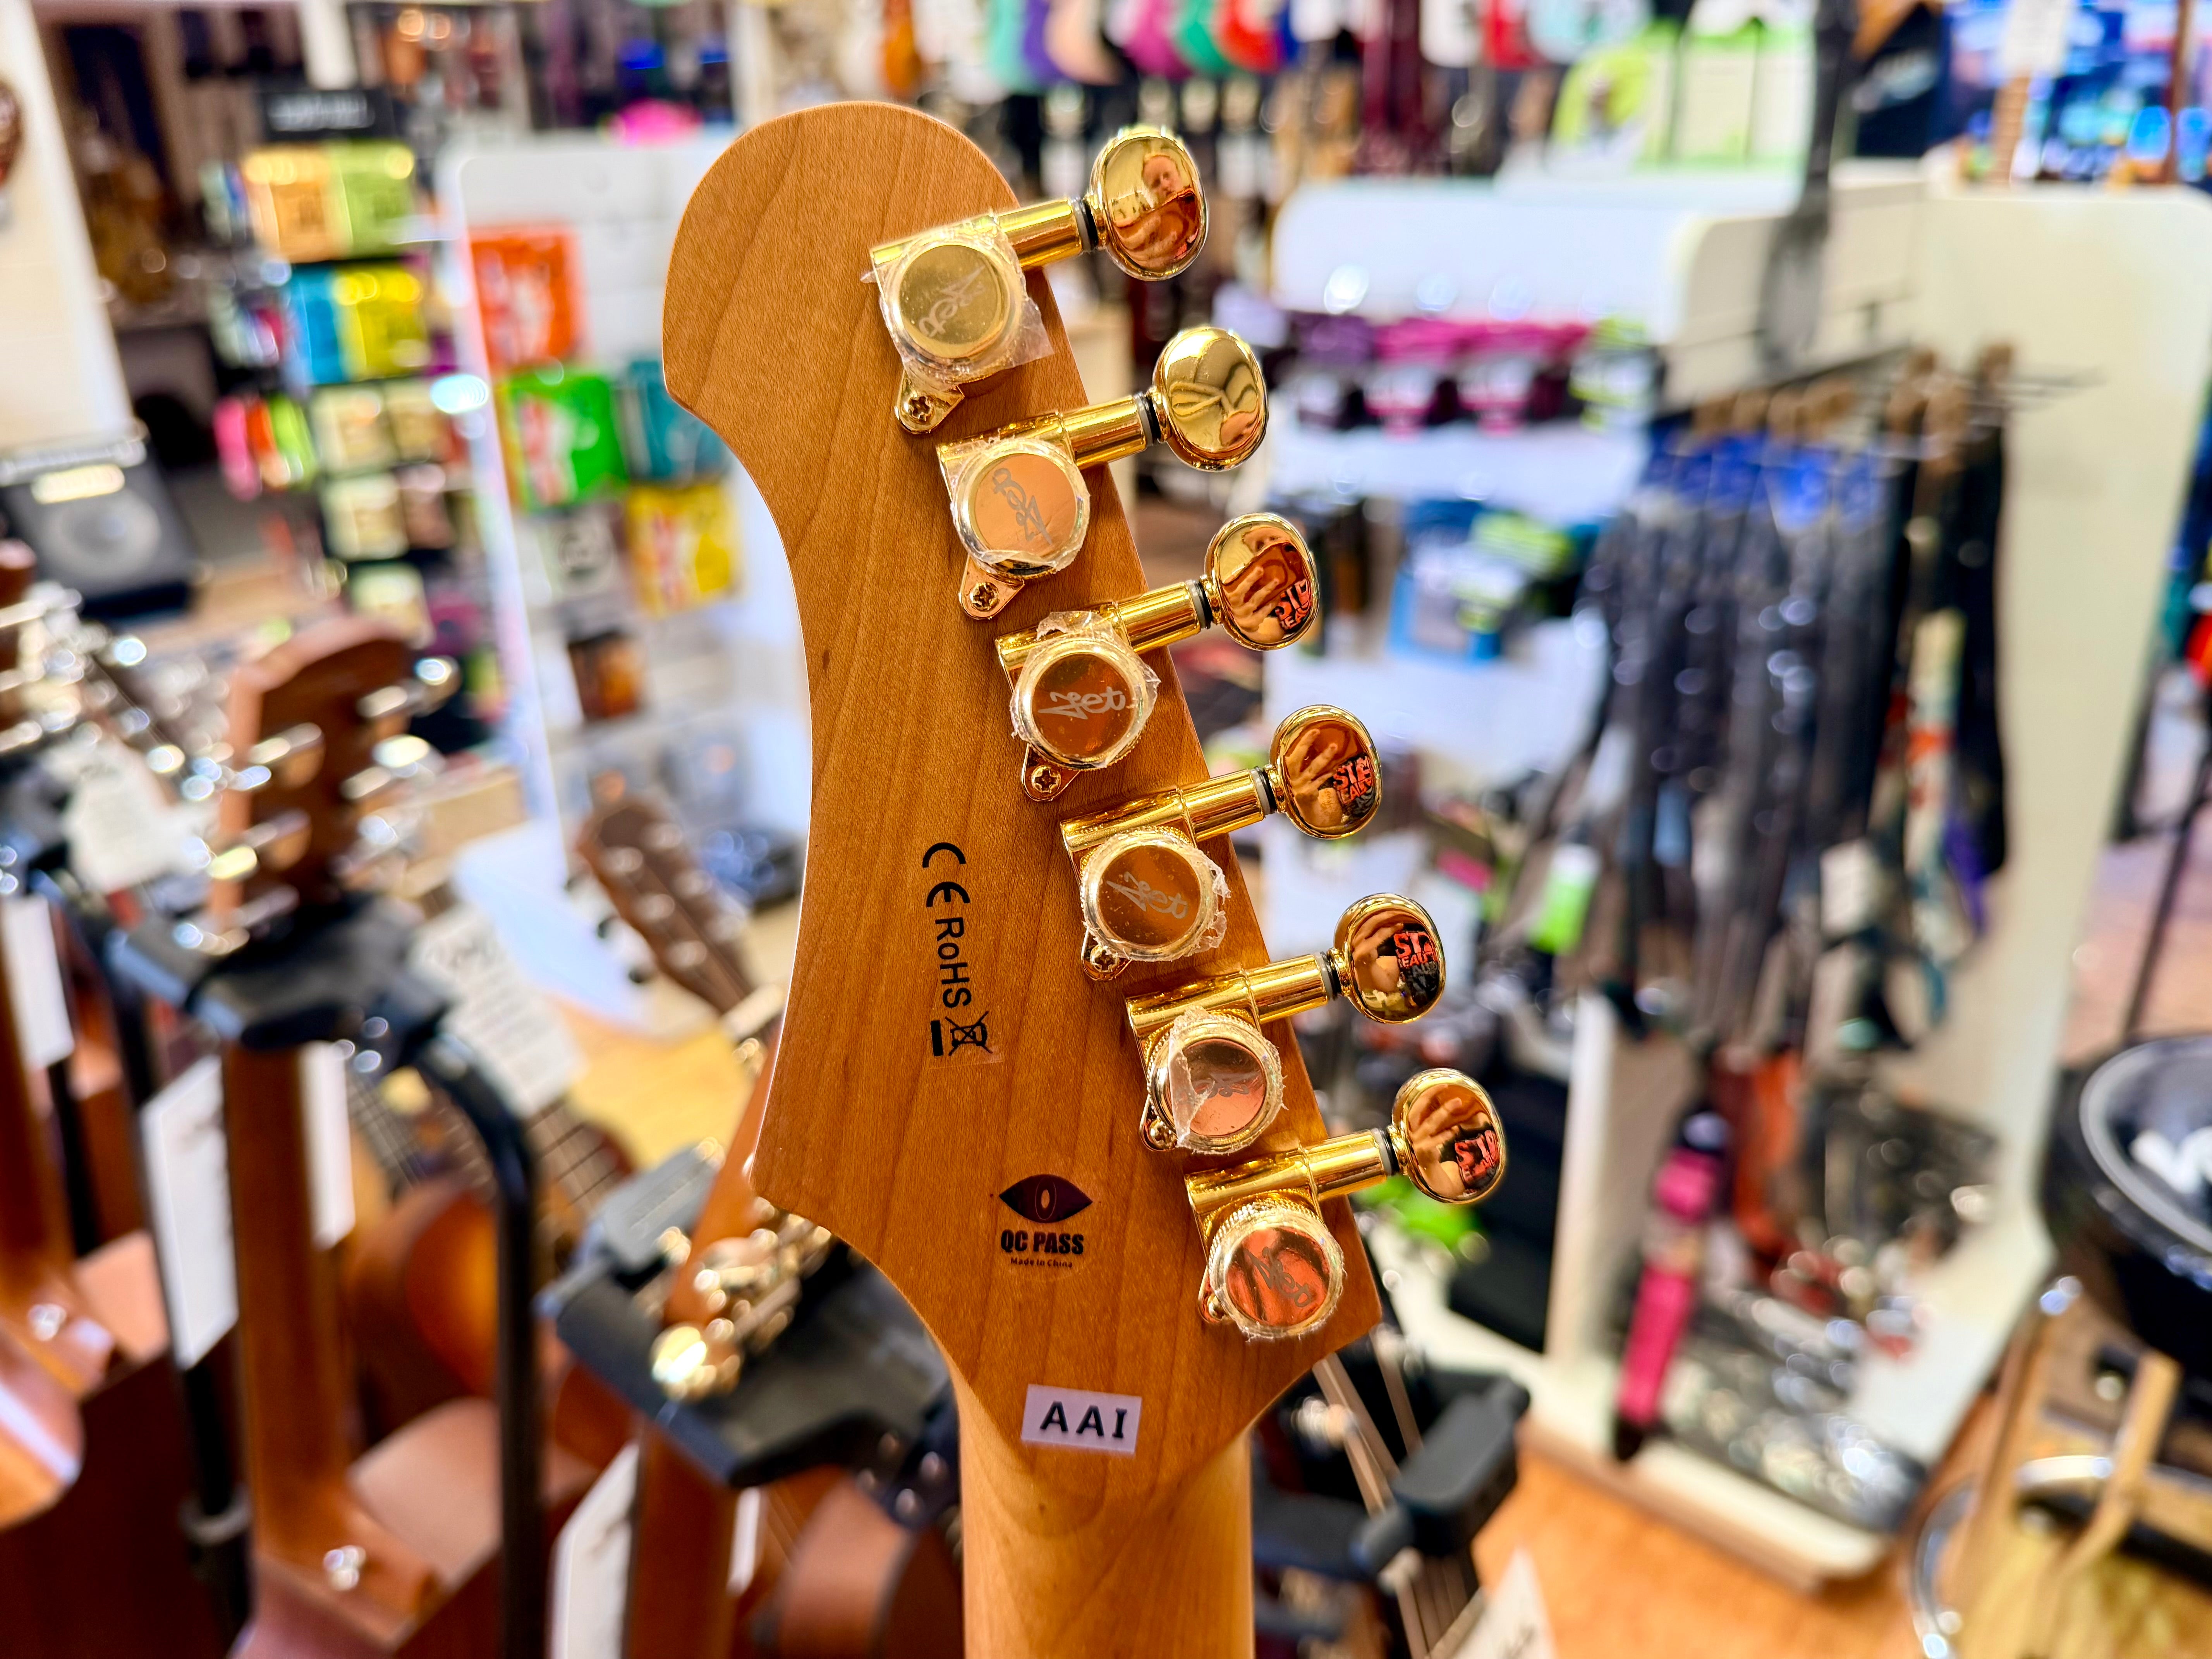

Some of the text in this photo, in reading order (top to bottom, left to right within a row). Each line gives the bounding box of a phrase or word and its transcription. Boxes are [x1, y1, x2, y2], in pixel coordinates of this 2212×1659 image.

[922, 842, 972, 1008] CE RoHS
[1001, 1229, 1084, 1255] QC PASS
[1011, 1257, 1034, 1266] Made
[1047, 1259, 1072, 1268] China
[1039, 1400, 1127, 1438] AAI
